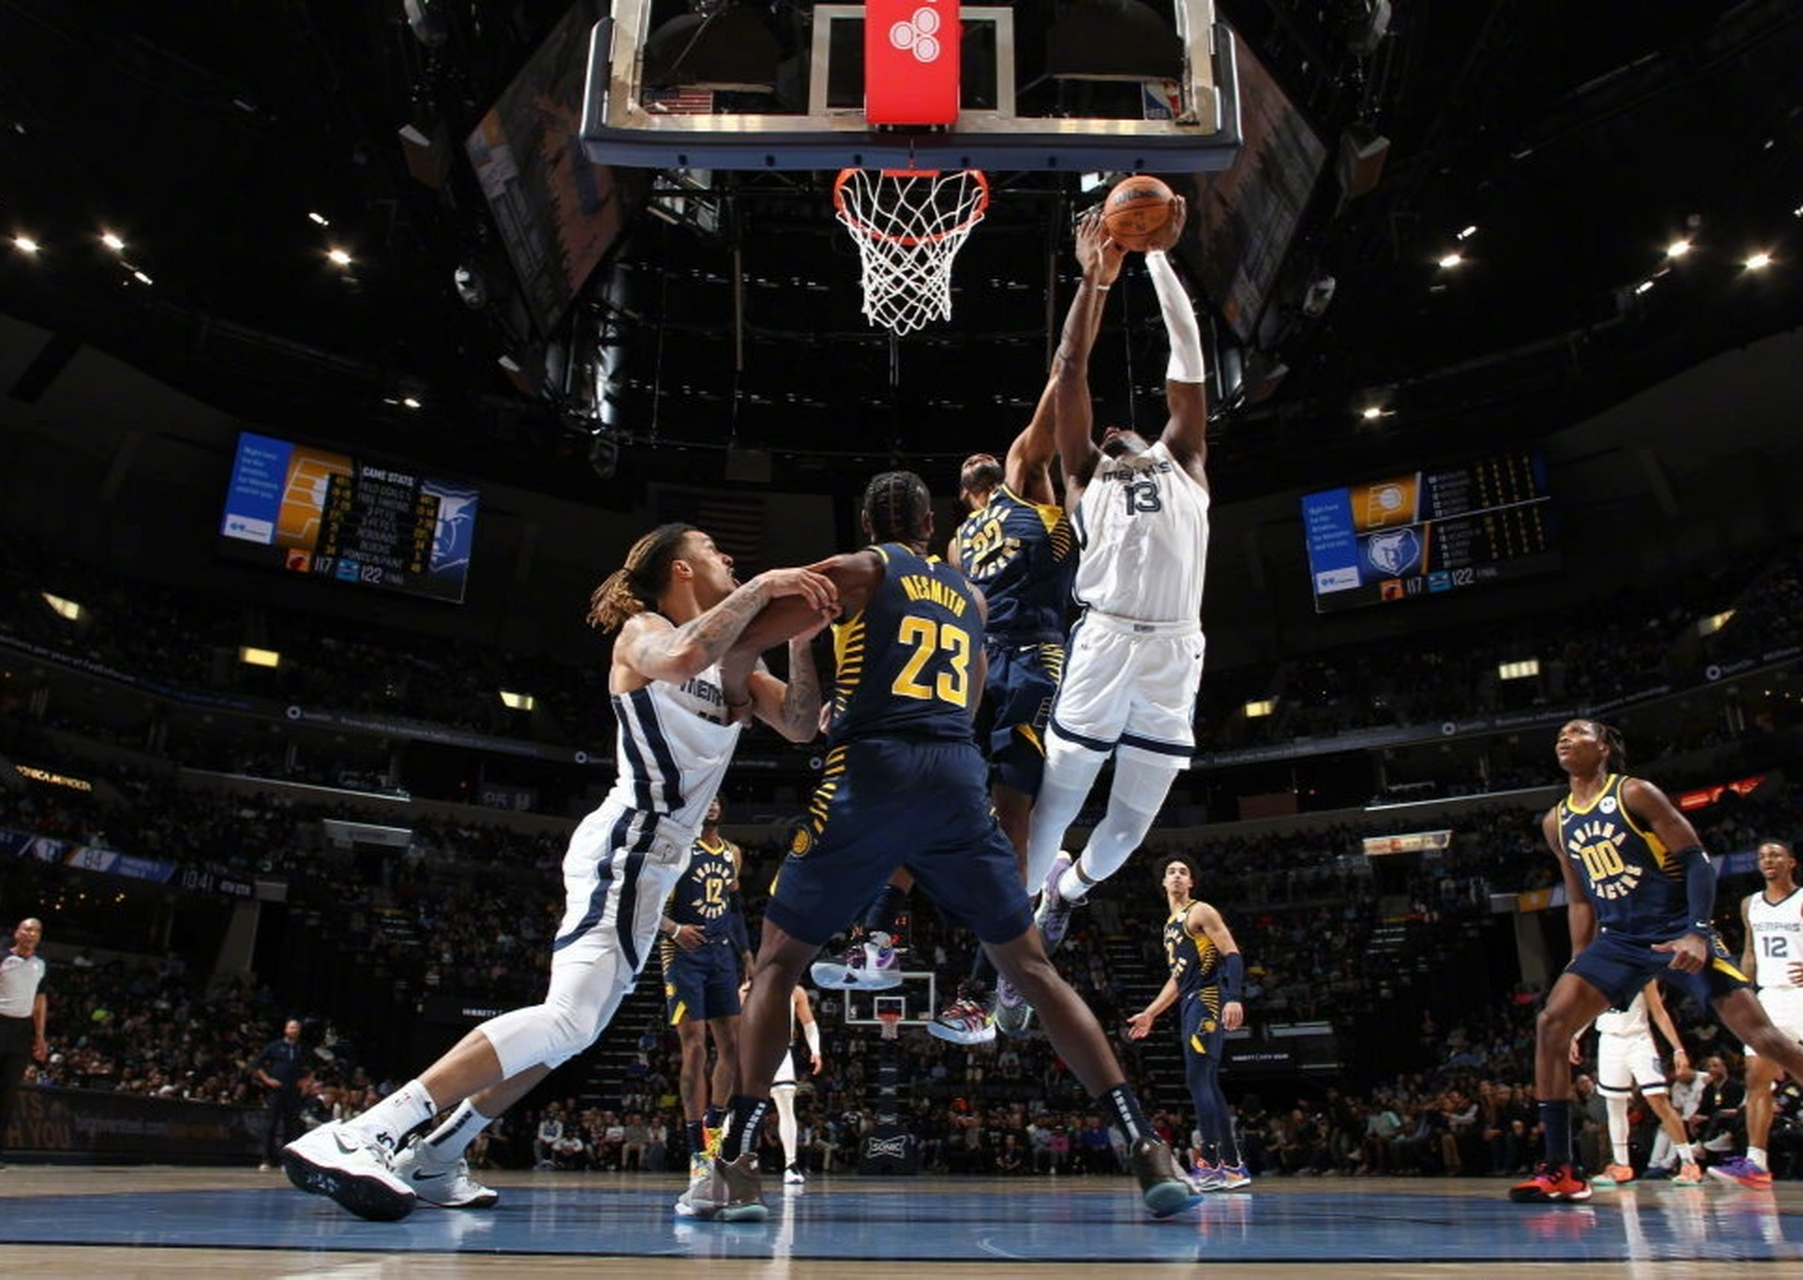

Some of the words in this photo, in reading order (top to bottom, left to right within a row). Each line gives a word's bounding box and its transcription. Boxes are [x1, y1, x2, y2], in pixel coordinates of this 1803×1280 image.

[1124, 480, 1161, 516] 13
[971, 518, 1004, 567] 22
[361, 564, 384, 584] 122
[1451, 567, 1476, 586] 122
[899, 574, 967, 618] NESMITH
[891, 615, 970, 709] 23
[1568, 820, 1627, 860] INDIANA
[691, 861, 734, 886] INDIANA
[1580, 839, 1625, 882] 00
[704, 877, 724, 904] 12
[1762, 936, 1788, 958] 12
[871, 1142, 903, 1153] SONIC
